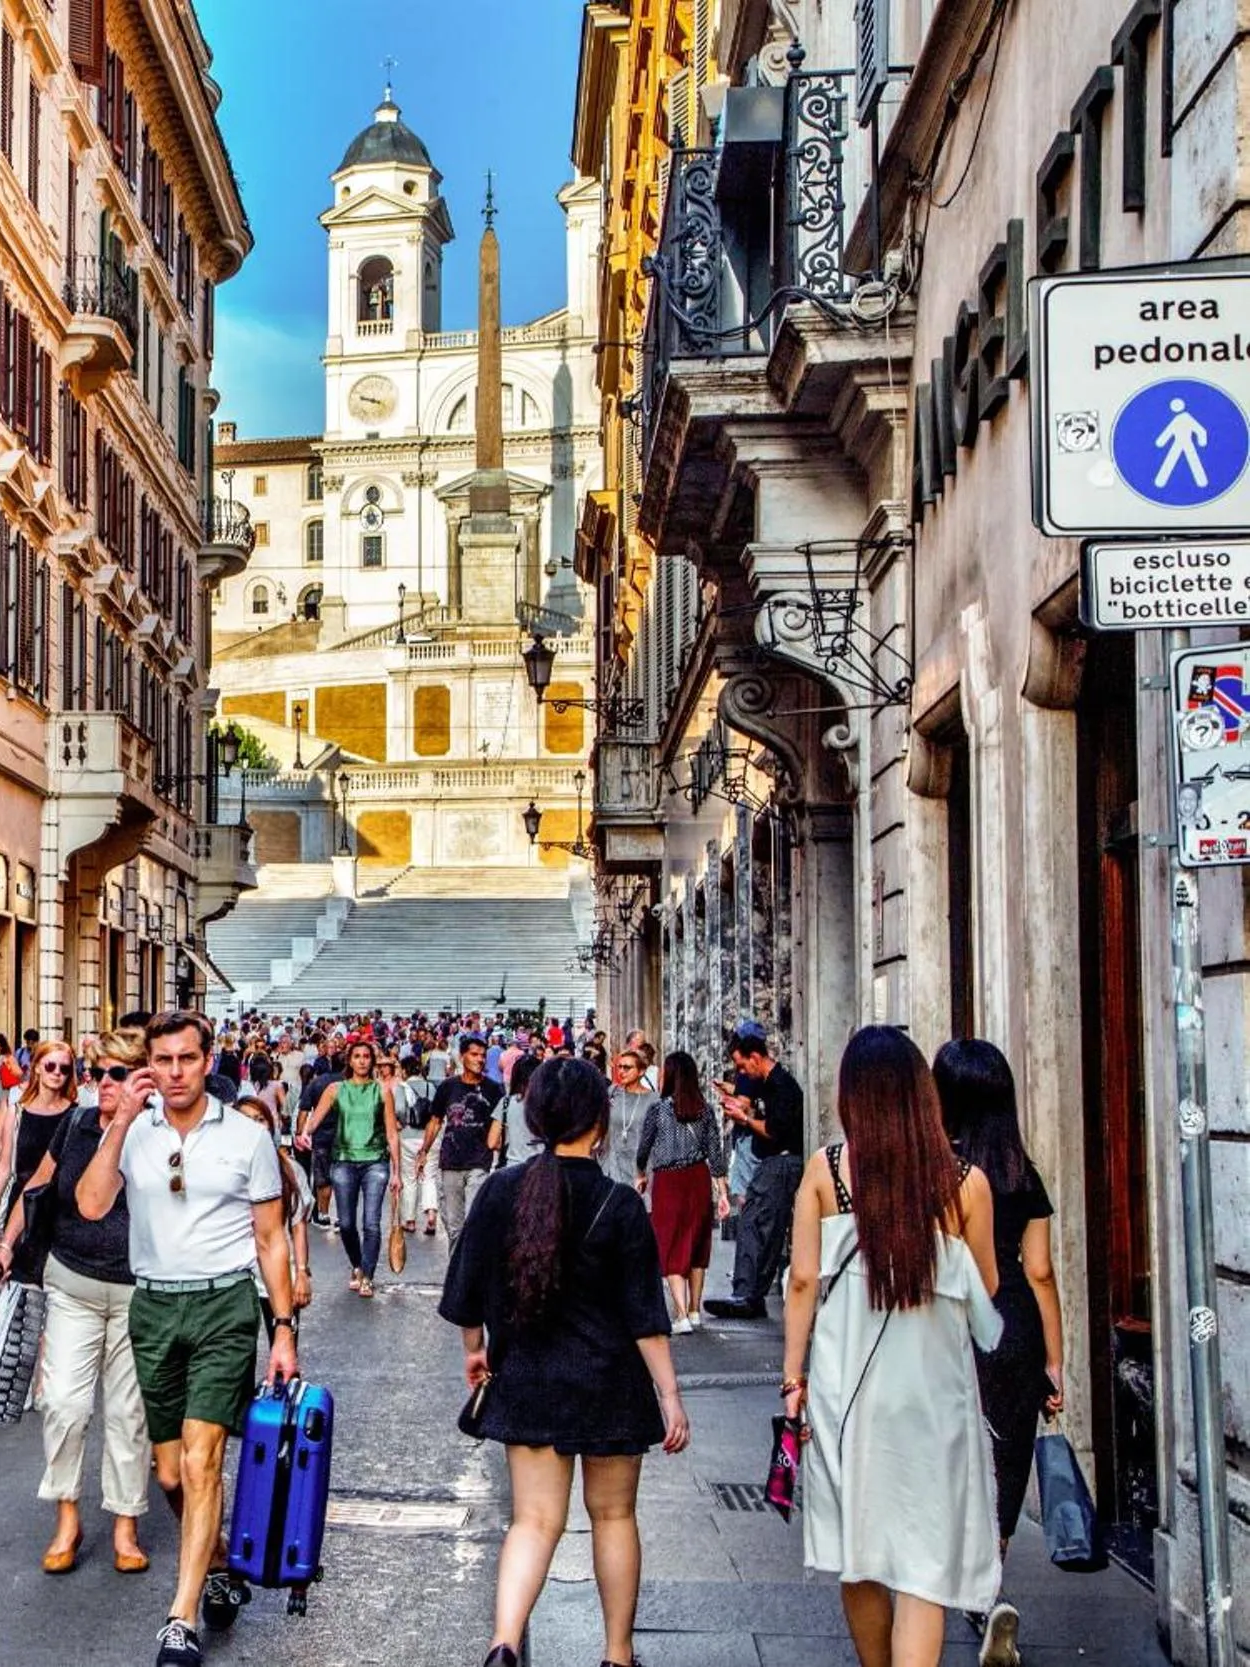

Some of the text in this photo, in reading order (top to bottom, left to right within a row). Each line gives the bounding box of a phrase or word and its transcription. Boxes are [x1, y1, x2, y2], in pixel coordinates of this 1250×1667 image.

[1139, 297, 1220, 322] area
[1133, 550, 1231, 570] escluso
[1110, 575, 1233, 595] biciclette
